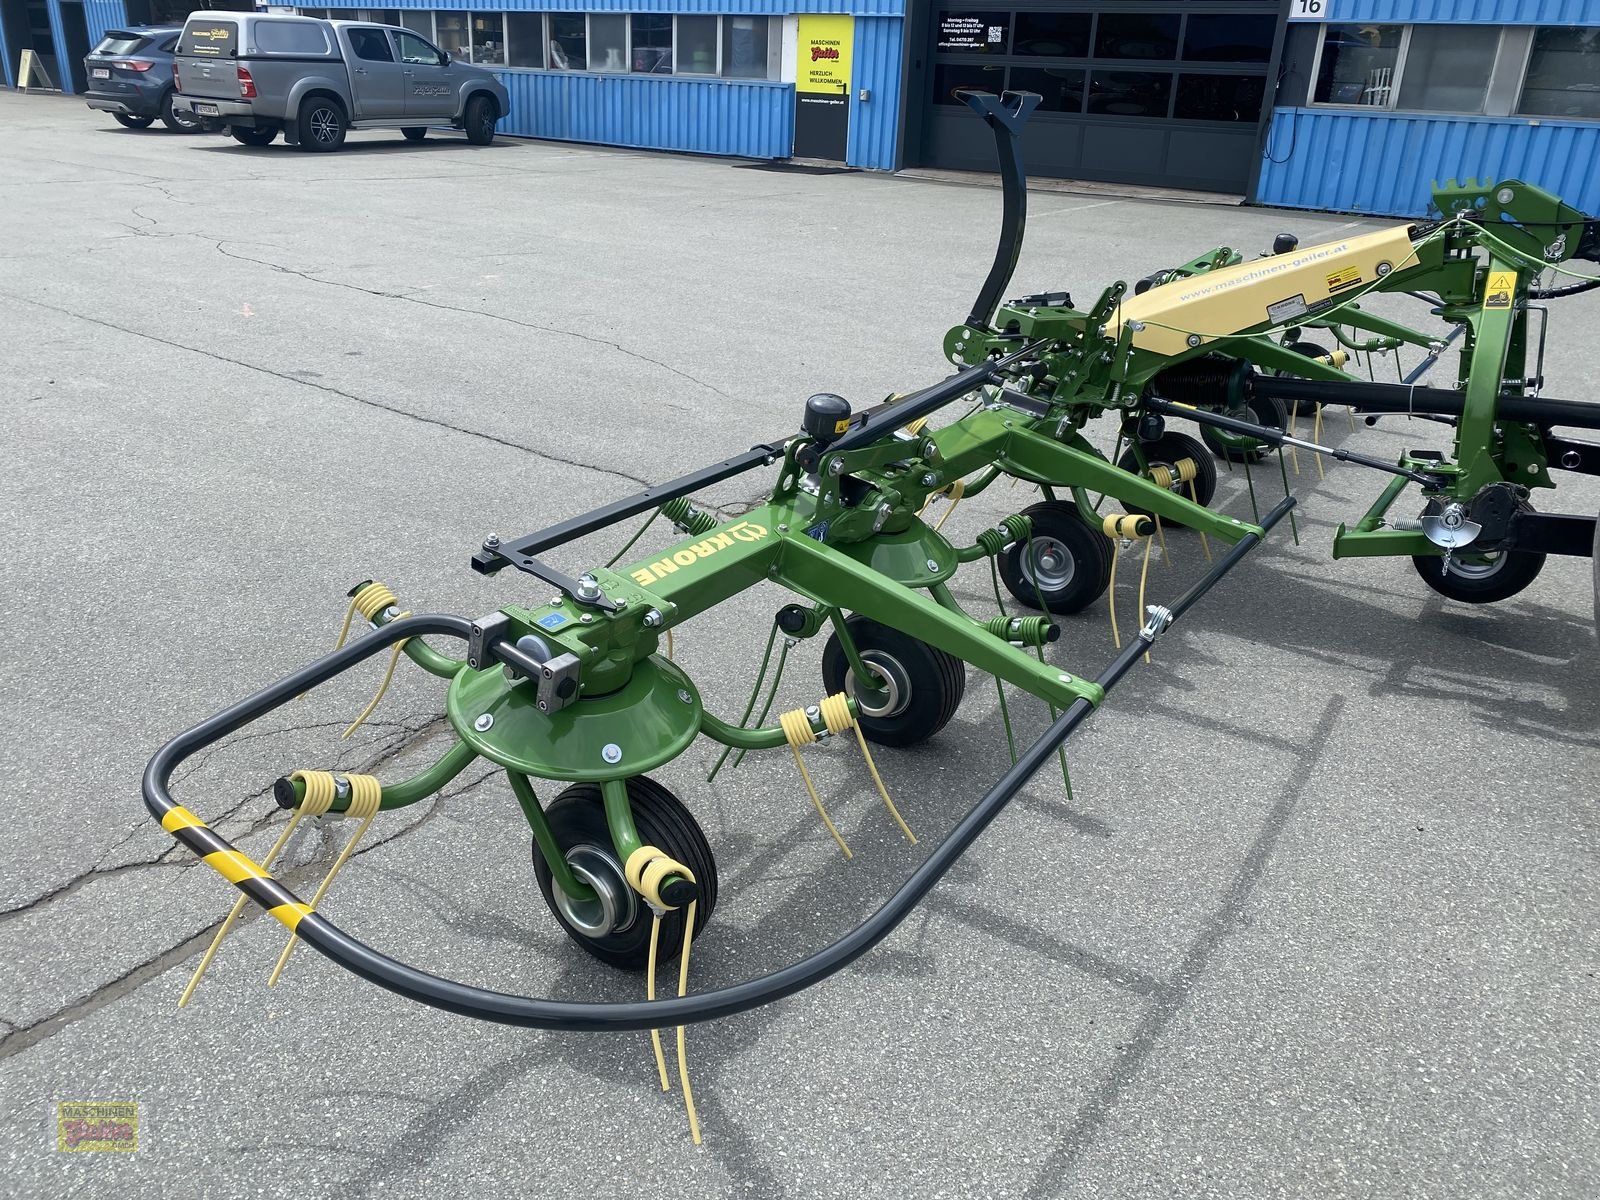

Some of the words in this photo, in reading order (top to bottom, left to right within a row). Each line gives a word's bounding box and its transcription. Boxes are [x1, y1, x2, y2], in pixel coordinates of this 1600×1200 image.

[1300, 0, 1321, 13] 16
[811, 46, 840, 62] Gailer
[1180, 244, 1349, 301] www.maschinen-gailer.at
[630, 532, 735, 587] KRONE
